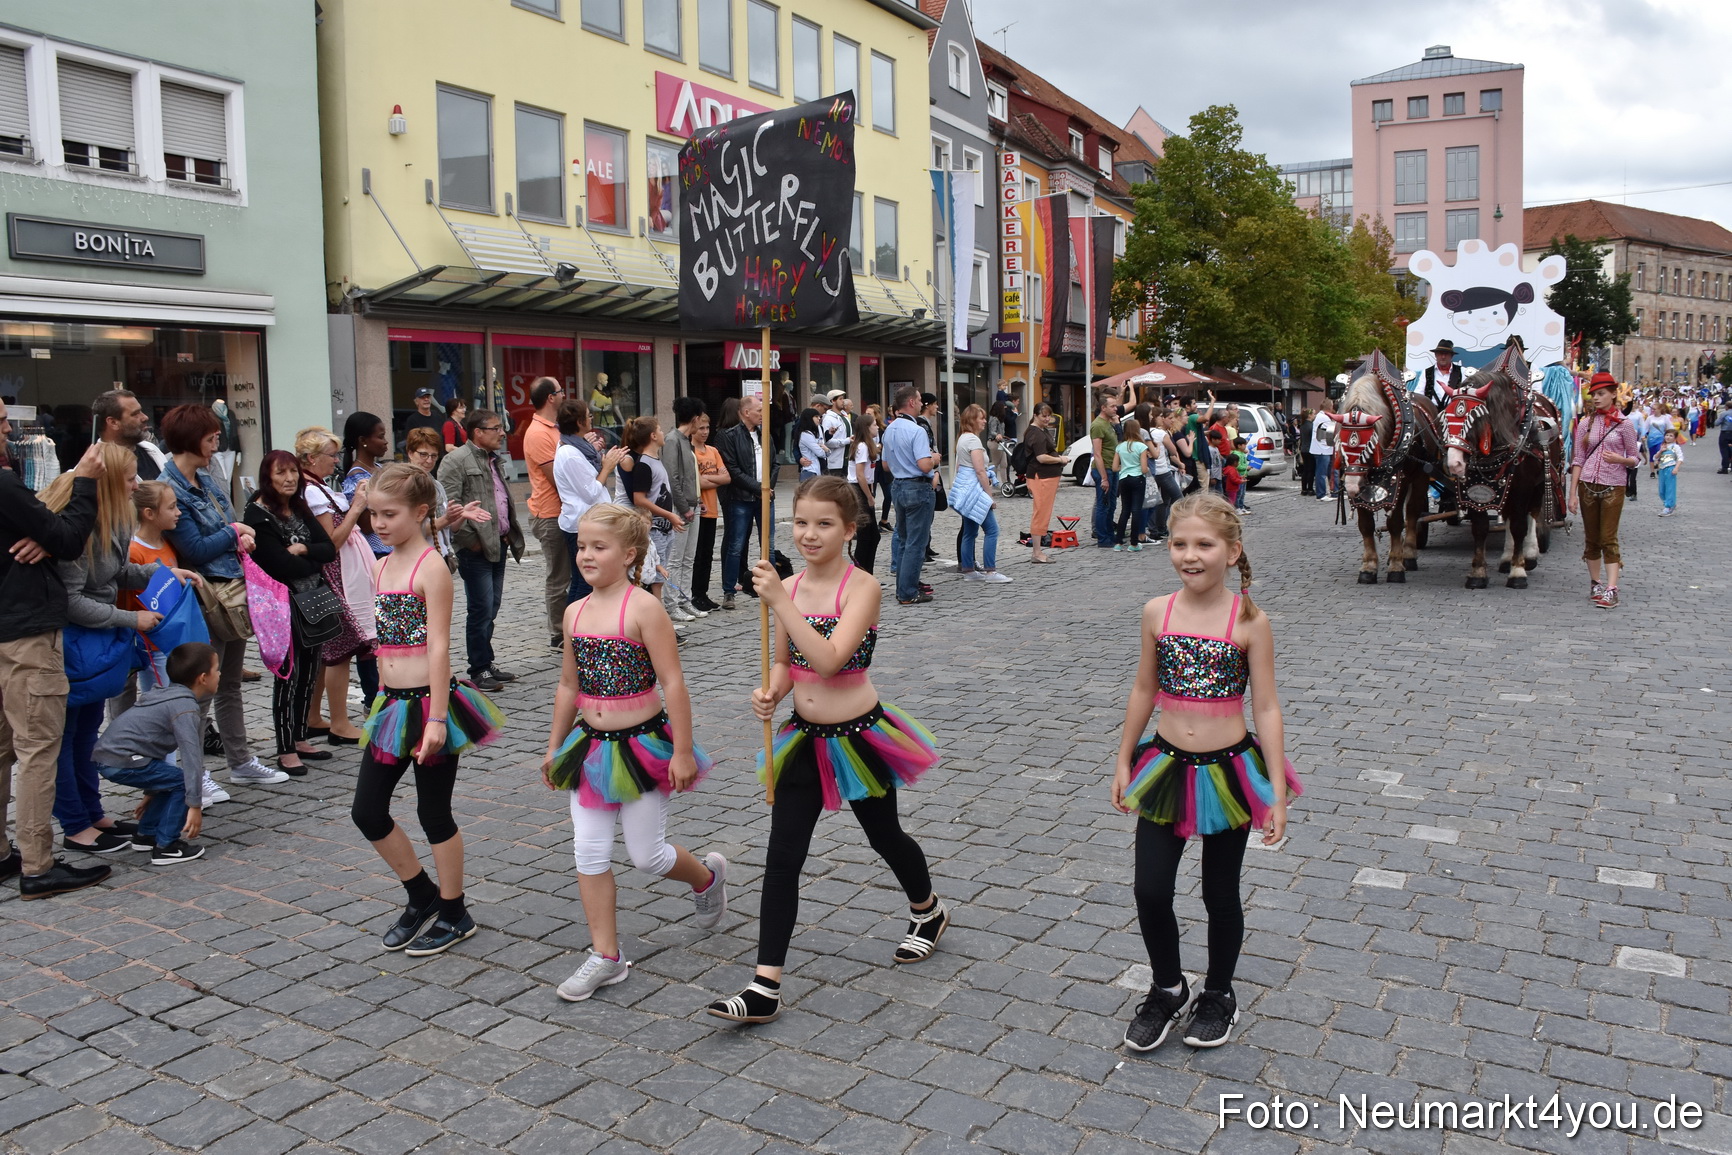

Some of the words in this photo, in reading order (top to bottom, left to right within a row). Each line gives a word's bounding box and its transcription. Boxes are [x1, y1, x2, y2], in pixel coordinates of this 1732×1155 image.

[828, 98, 853, 124] NO
[683, 164, 711, 191] KIDS
[689, 119, 774, 242] MAGIC
[1003, 153, 1017, 287] BÄCKEREI
[744, 255, 807, 302] HAPPY
[735, 294, 797, 326] HOPPERS
[1004, 292, 1020, 303] café
[732, 342, 781, 370] ADLR
[993, 337, 1020, 349] liberty
[1282, 361, 1288, 376] P
[511, 375, 576, 406] SE
